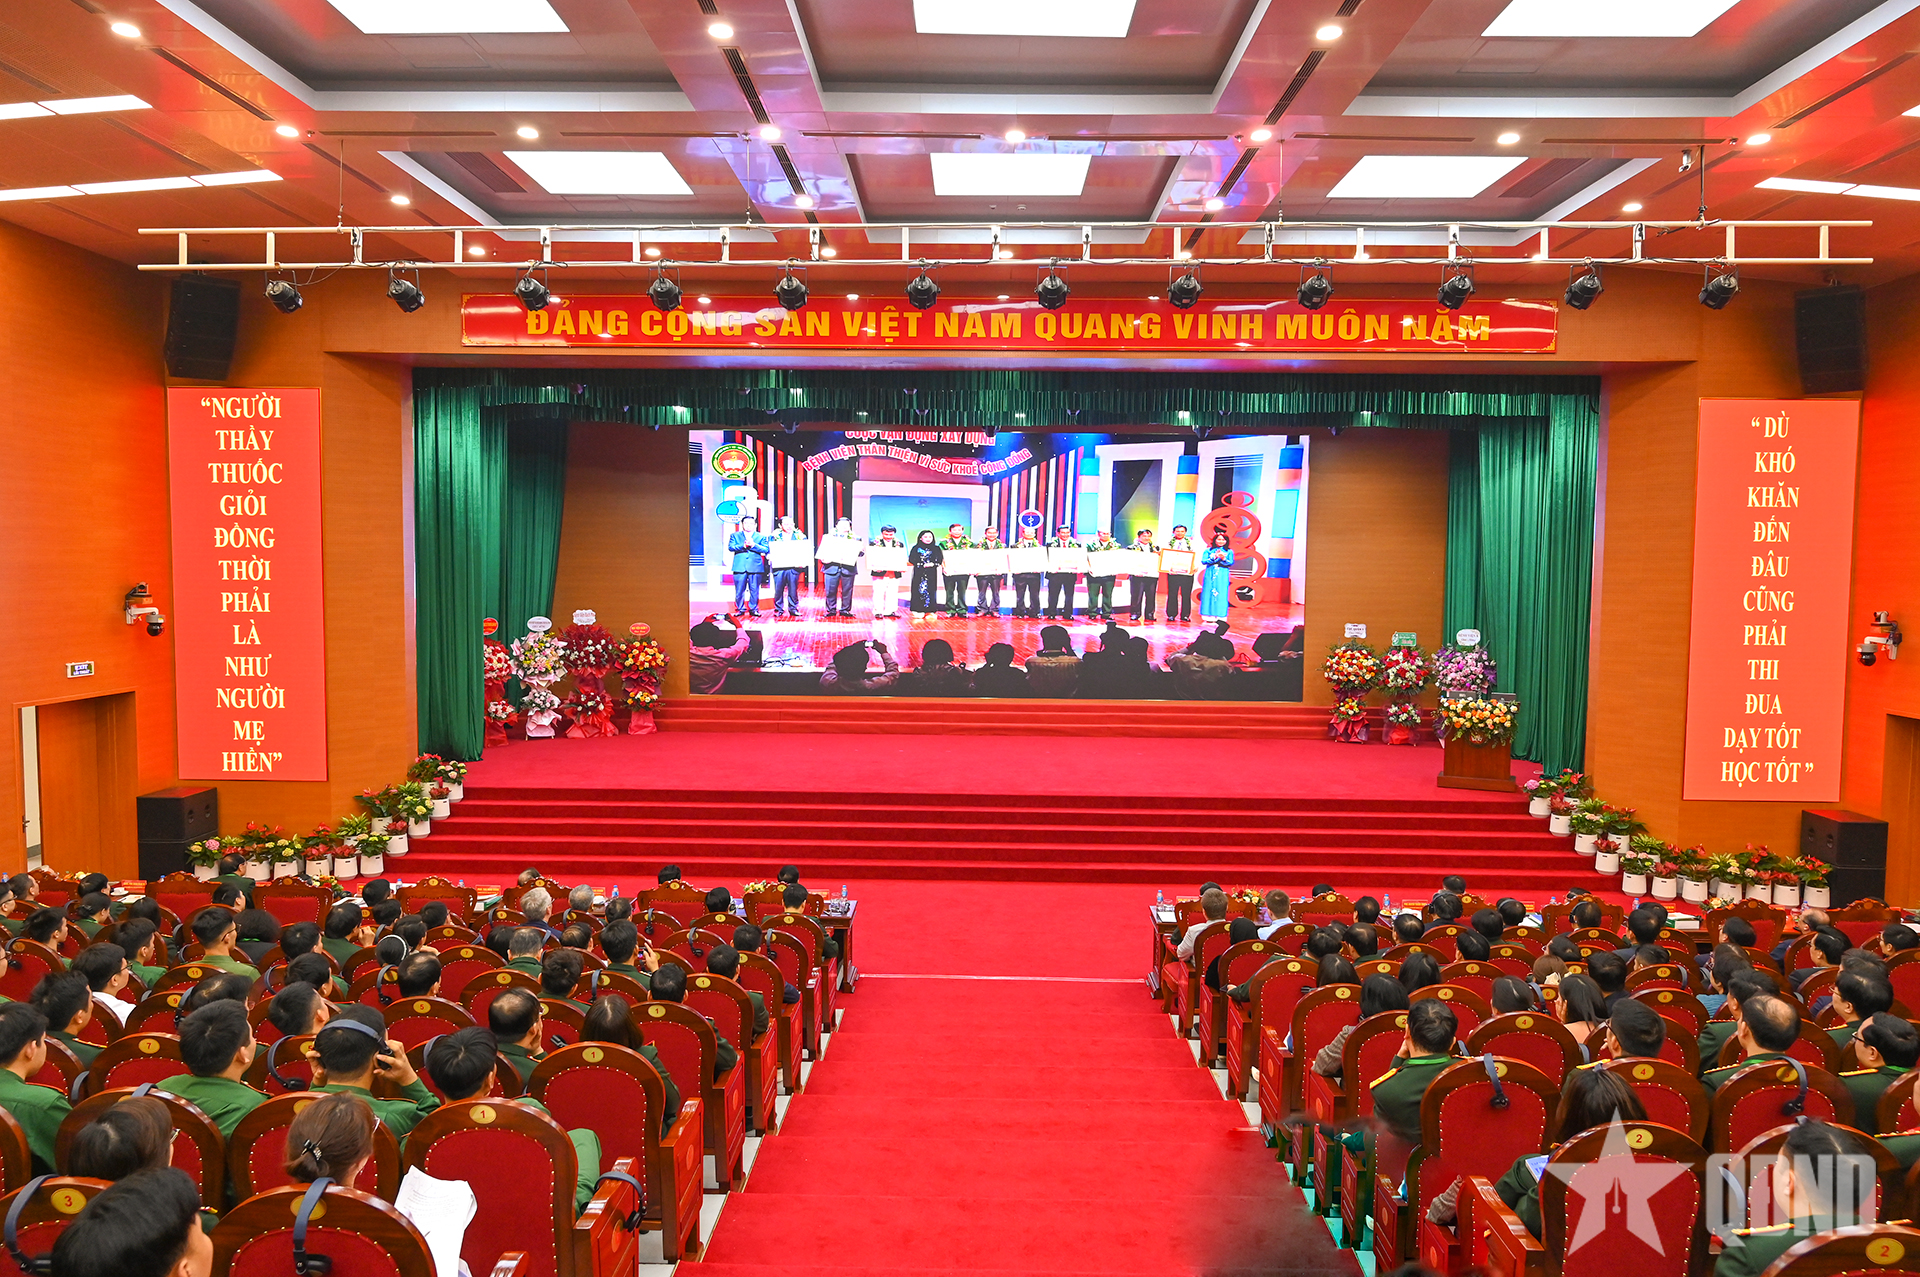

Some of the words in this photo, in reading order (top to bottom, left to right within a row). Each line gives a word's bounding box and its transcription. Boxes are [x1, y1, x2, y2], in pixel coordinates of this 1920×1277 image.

[526, 300, 629, 336] ĐẢNG
[640, 304, 742, 340] CỘNG
[843, 306, 922, 343] VIỆT
[935, 311, 1021, 338] NAM
[1035, 312, 1160, 341] QUANG
[1173, 313, 1262, 340] VINH
[1277, 308, 1388, 341] MUÔN
[1402, 308, 1490, 340] NĂM
[201, 392, 281, 418] “NGƯỜI
[1764, 411, 1789, 438] DÙ
[216, 425, 274, 450] THẦY
[803, 452, 831, 471] BỆNH
[829, 445, 856, 461] VIỆN
[857, 443, 886, 455] THÂN
[888, 446, 918, 464] THIỆN
[918, 455, 932, 467] VÌ
[931, 459, 950, 473] SỨC
[1755, 446, 1795, 473] KHÓ
[208, 458, 282, 484] THUỐC
[220, 489, 267, 516] GIỎI
[1747, 481, 1799, 507] KHĂN
[214, 523, 275, 548] ĐỒNG
[1754, 515, 1790, 542] ĐẾN
[219, 555, 271, 580] THỜI
[1751, 550, 1789, 577] ĐÂU
[221, 586, 270, 612] PHẢI
[1743, 585, 1794, 612] CŨNG
[233, 619, 261, 644] LÀ
[1743, 619, 1787, 645] PHẢI
[225, 654, 272, 677] NHƯ
[1748, 660, 1779, 680] THI
[216, 683, 285, 708] NGƯỜI
[1745, 694, 1782, 714] ĐUA
[233, 721, 265, 746] MẸ
[1724, 728, 1761, 753] DẠY
[1765, 722, 1801, 748] TỐT
[222, 747, 282, 772] HIỀN”
[1721, 762, 1760, 787] HỌC
[1765, 756, 1801, 782] TỐT
[591, 1051, 596, 1059] 1
[1640, 1068, 1646, 1076] 4
[480, 1110, 486, 1119] 1
[1636, 1134, 1643, 1143] 2
[64, 1195, 73, 1207] 3
[1880, 1245, 1890, 1257] 2
